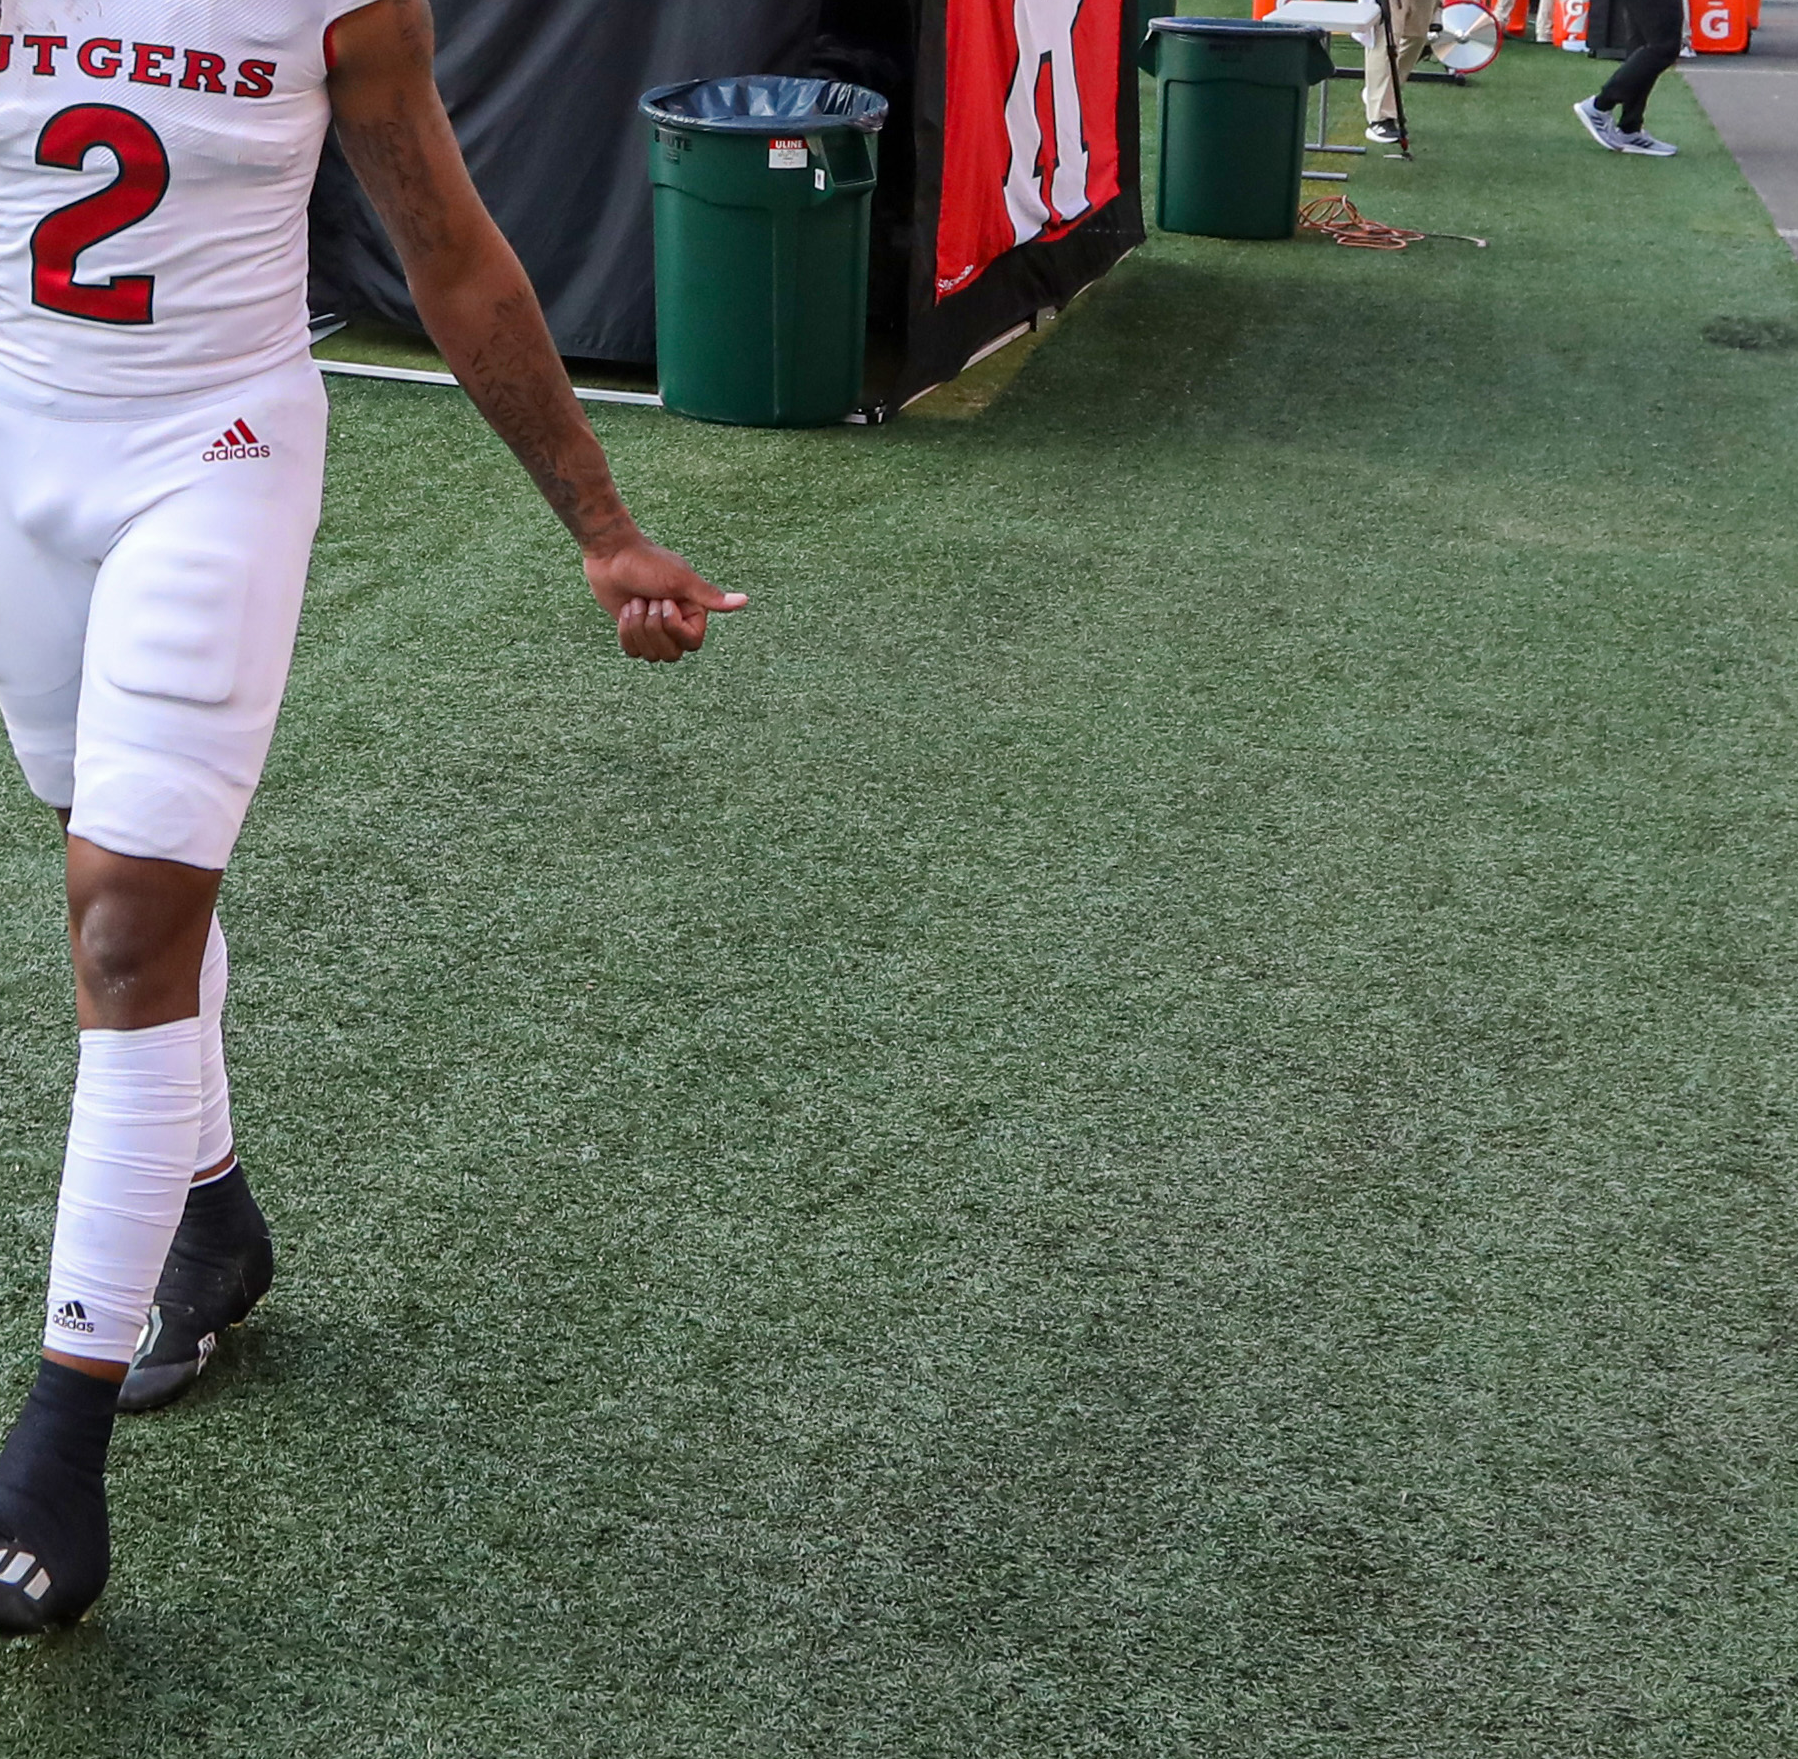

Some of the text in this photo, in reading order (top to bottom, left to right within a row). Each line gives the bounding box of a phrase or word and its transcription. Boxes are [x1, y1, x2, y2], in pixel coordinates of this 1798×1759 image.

[1700, 9, 1729, 39] G
[775, 140, 803, 150] ULINE
[30, 102, 170, 324] 2
[202, 444, 271, 462] adidas
[53, 1314, 95, 1333] adidas
